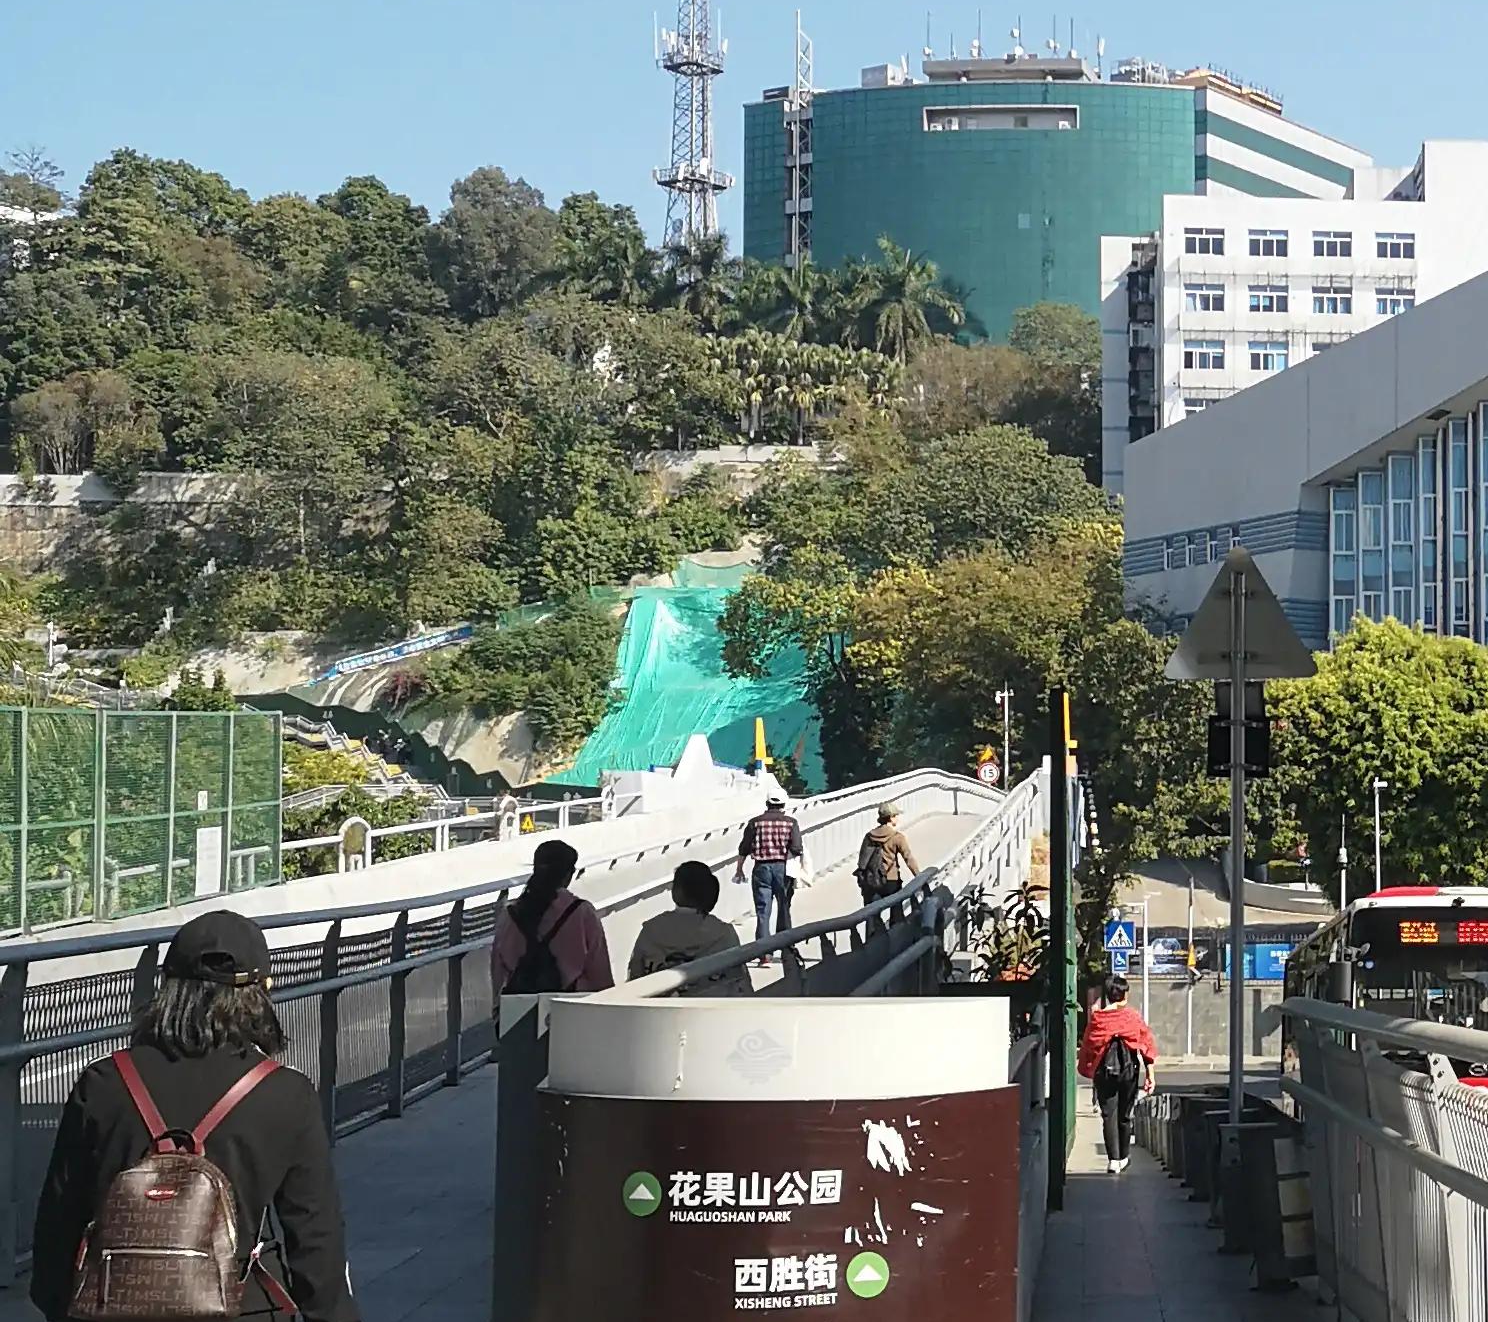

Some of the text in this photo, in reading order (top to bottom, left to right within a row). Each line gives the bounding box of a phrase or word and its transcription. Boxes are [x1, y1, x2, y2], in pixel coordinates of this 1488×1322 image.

[983, 769, 995, 778] 15
[668, 1169, 843, 1207] 花果山公园
[669, 1211, 792, 1223] HUAGUOSHAN PARK
[734, 1253, 838, 1293] 西胜街
[734, 1292, 838, 1310] XISHENG STREET
